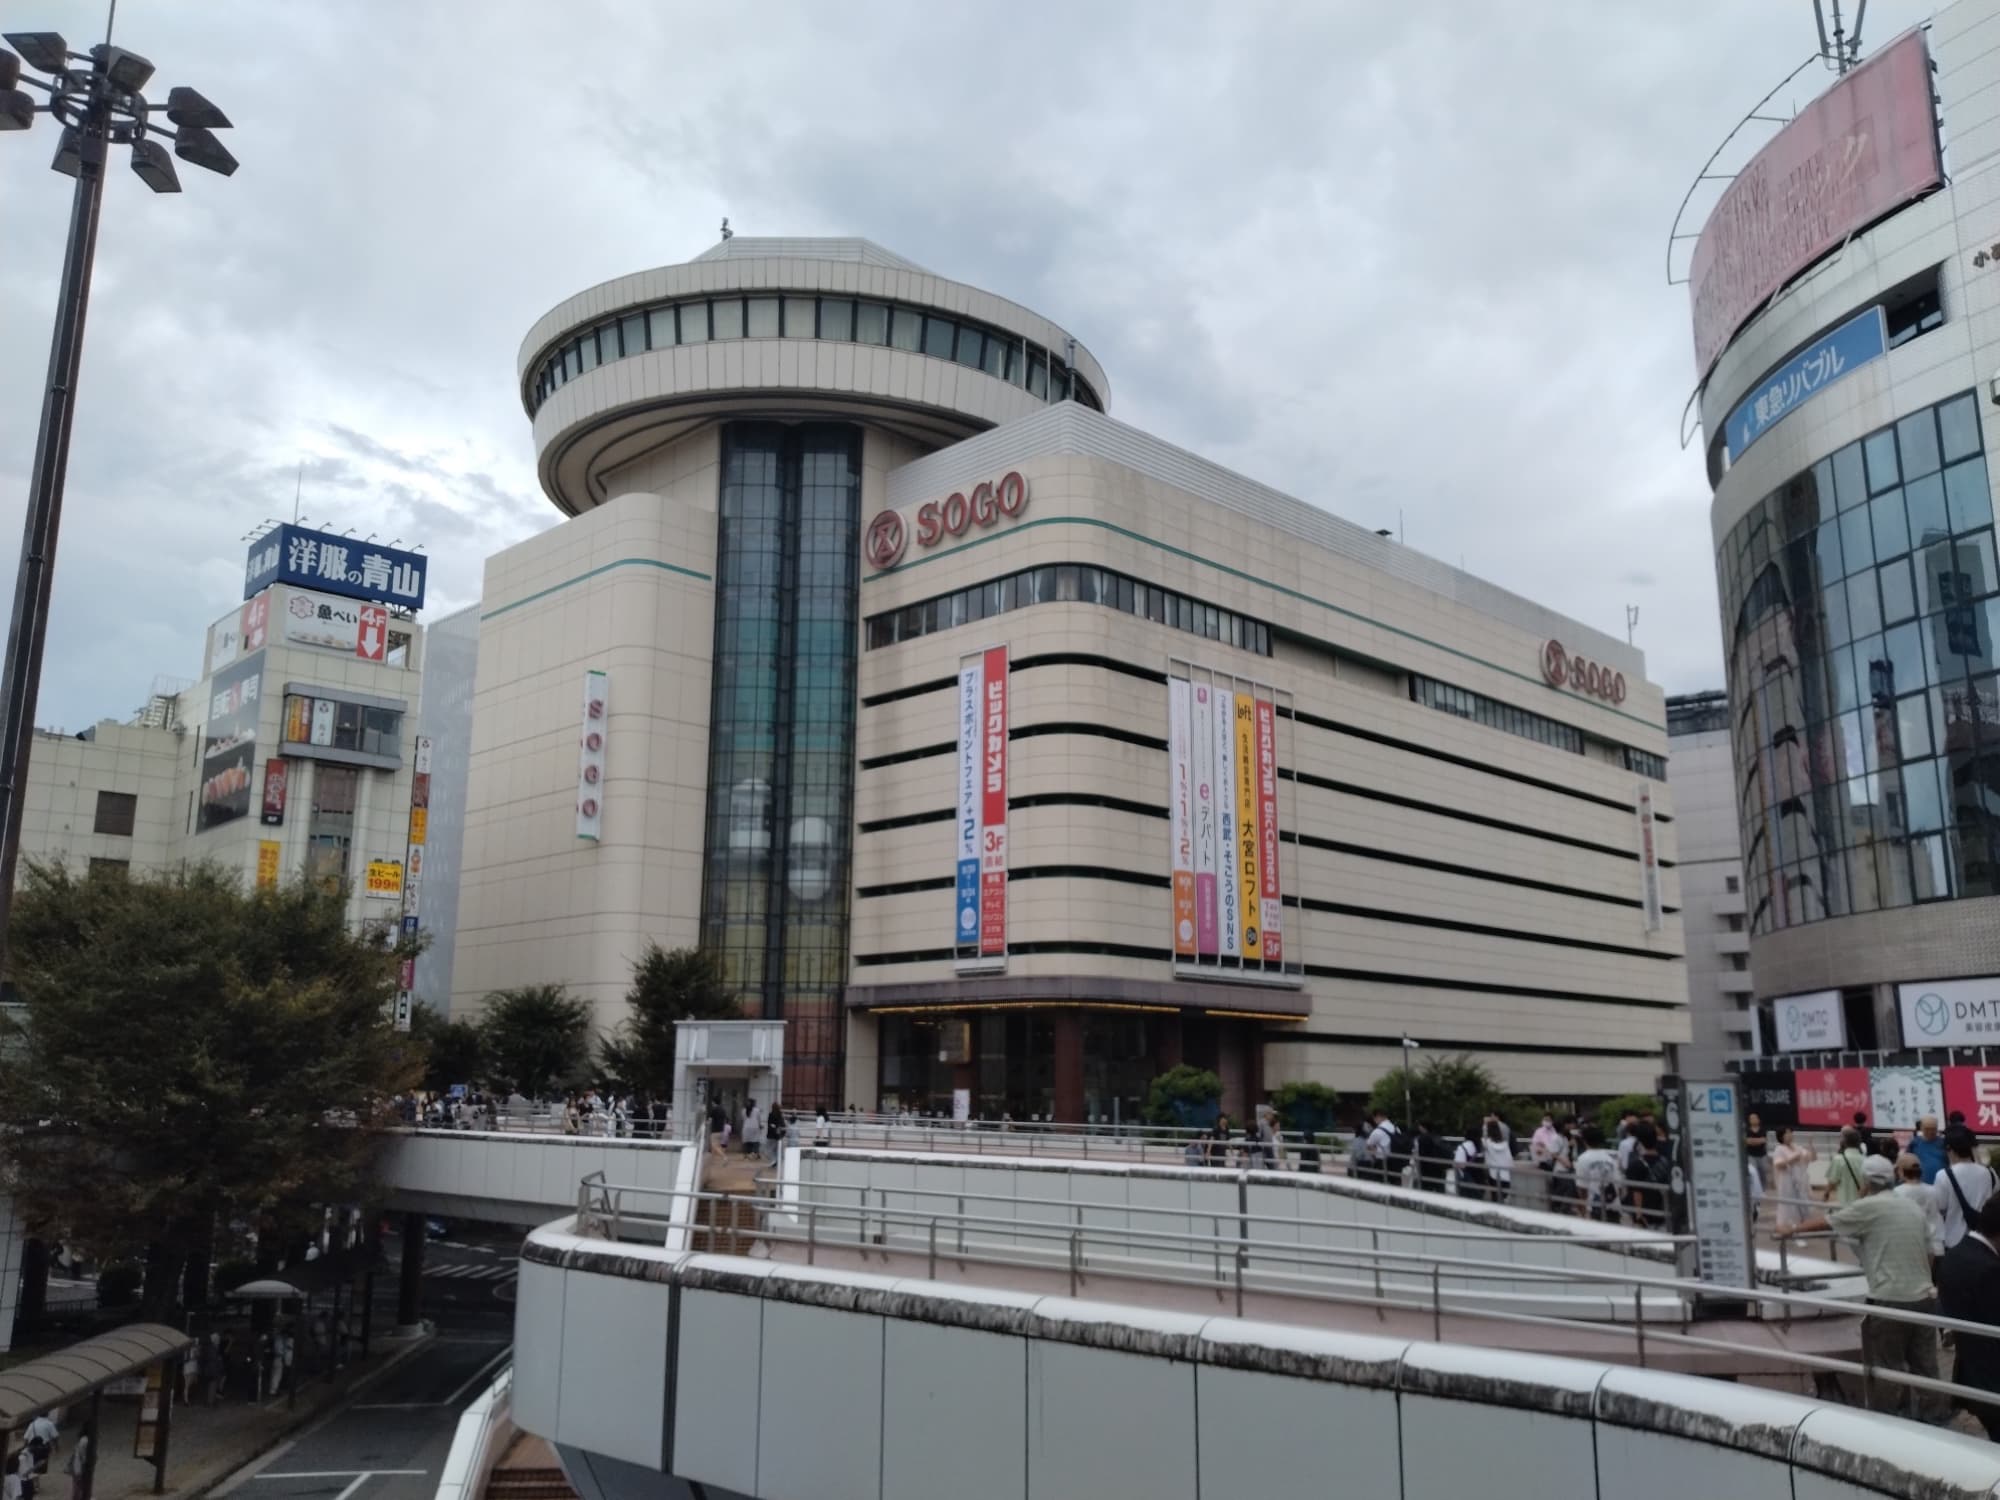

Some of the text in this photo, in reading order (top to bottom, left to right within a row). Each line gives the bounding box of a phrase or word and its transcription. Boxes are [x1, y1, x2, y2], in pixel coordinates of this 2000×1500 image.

[1754, 345, 1845, 430] 東急リバブル
[917, 471, 1028, 547] SOGO
[288, 537, 420, 599] 洋服の青山
[248, 601, 265, 626] 4F
[317, 603, 358, 624] 魚べい
[361, 607, 386, 627] 4F
[1571, 655, 1627, 705] SOGO
[1237, 704, 1252, 721] Loft
[985, 830, 1004, 852] 3F
[1264, 801, 1276, 894] BicCamera
[1243, 819, 1256, 916] 大宮ロフト
[1266, 939, 1280, 957] 3F
[1666, 1102, 1680, 1130] 6
[1669, 1134, 1680, 1161] 7
[1671, 1166, 1685, 1195] 8
